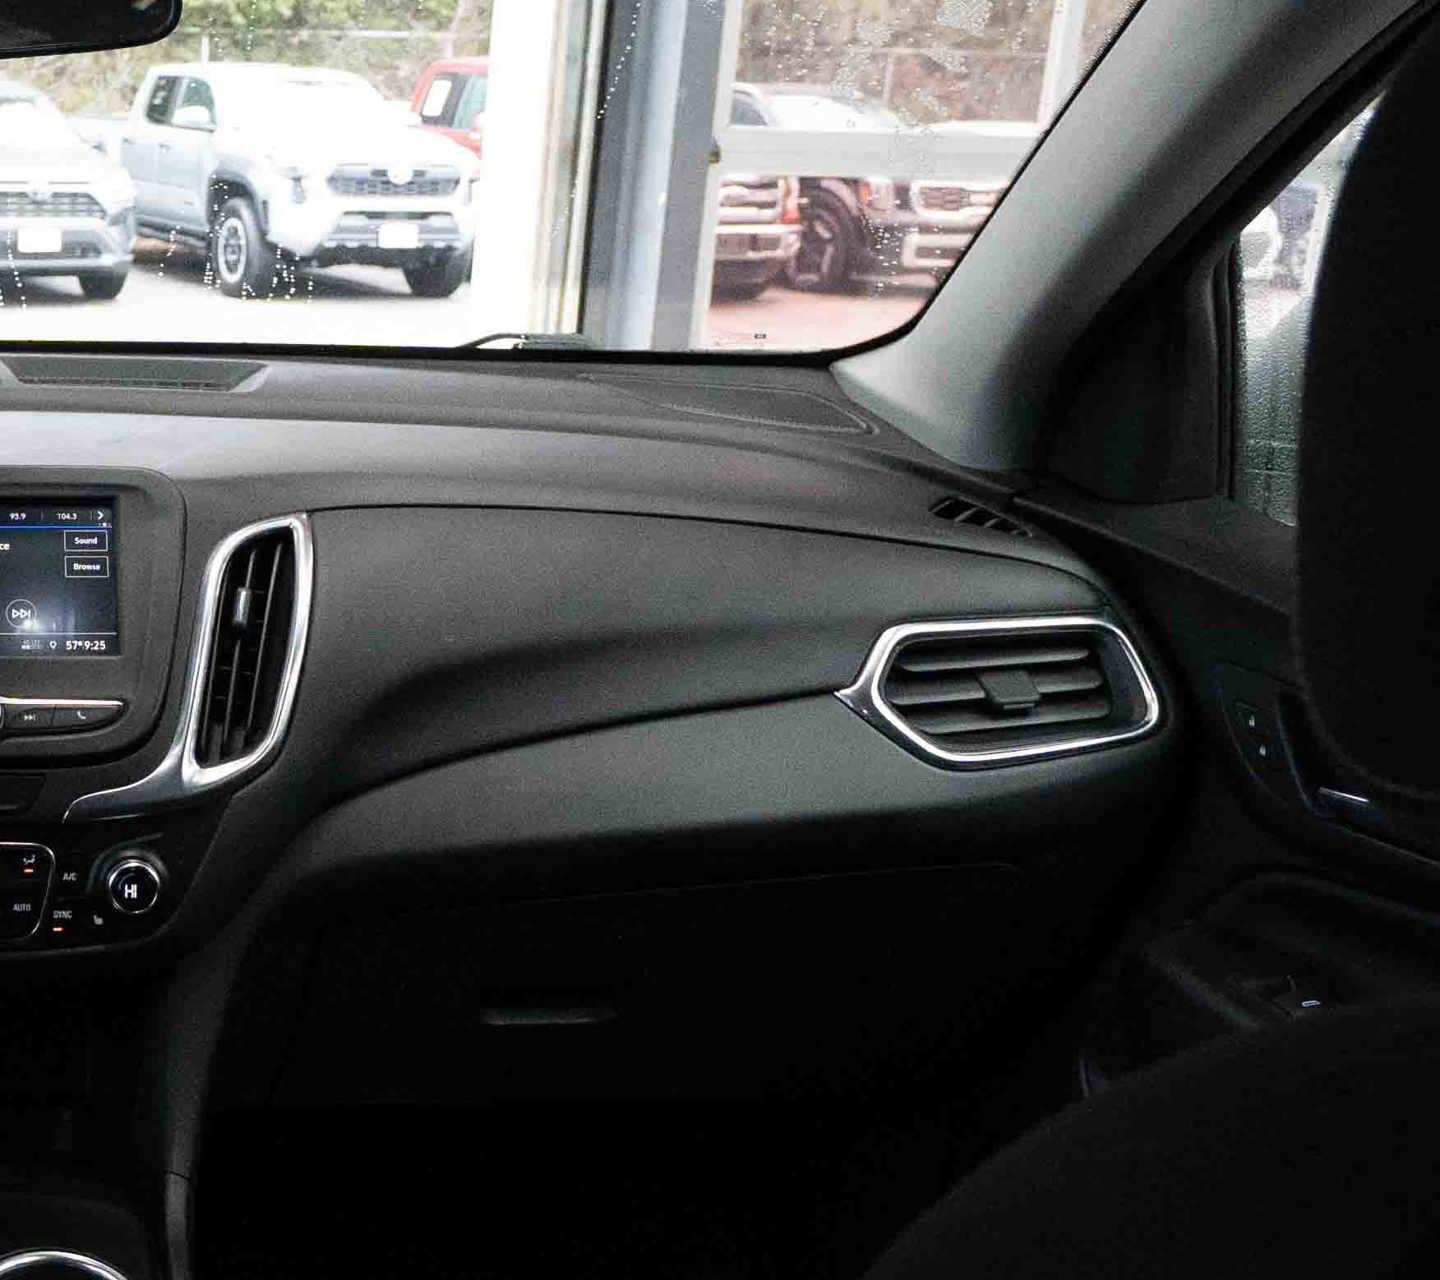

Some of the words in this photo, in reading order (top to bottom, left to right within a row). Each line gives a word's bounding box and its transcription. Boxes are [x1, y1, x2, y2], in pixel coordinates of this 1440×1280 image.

[73, 536, 98, 545] Sound
[72, 562, 101, 571] Browse
[84, 640, 106, 651] 9:25
[123, 883, 138, 899] HI
[12, 903, 31, 913] AUTO
[52, 910, 73, 919] SYNC
